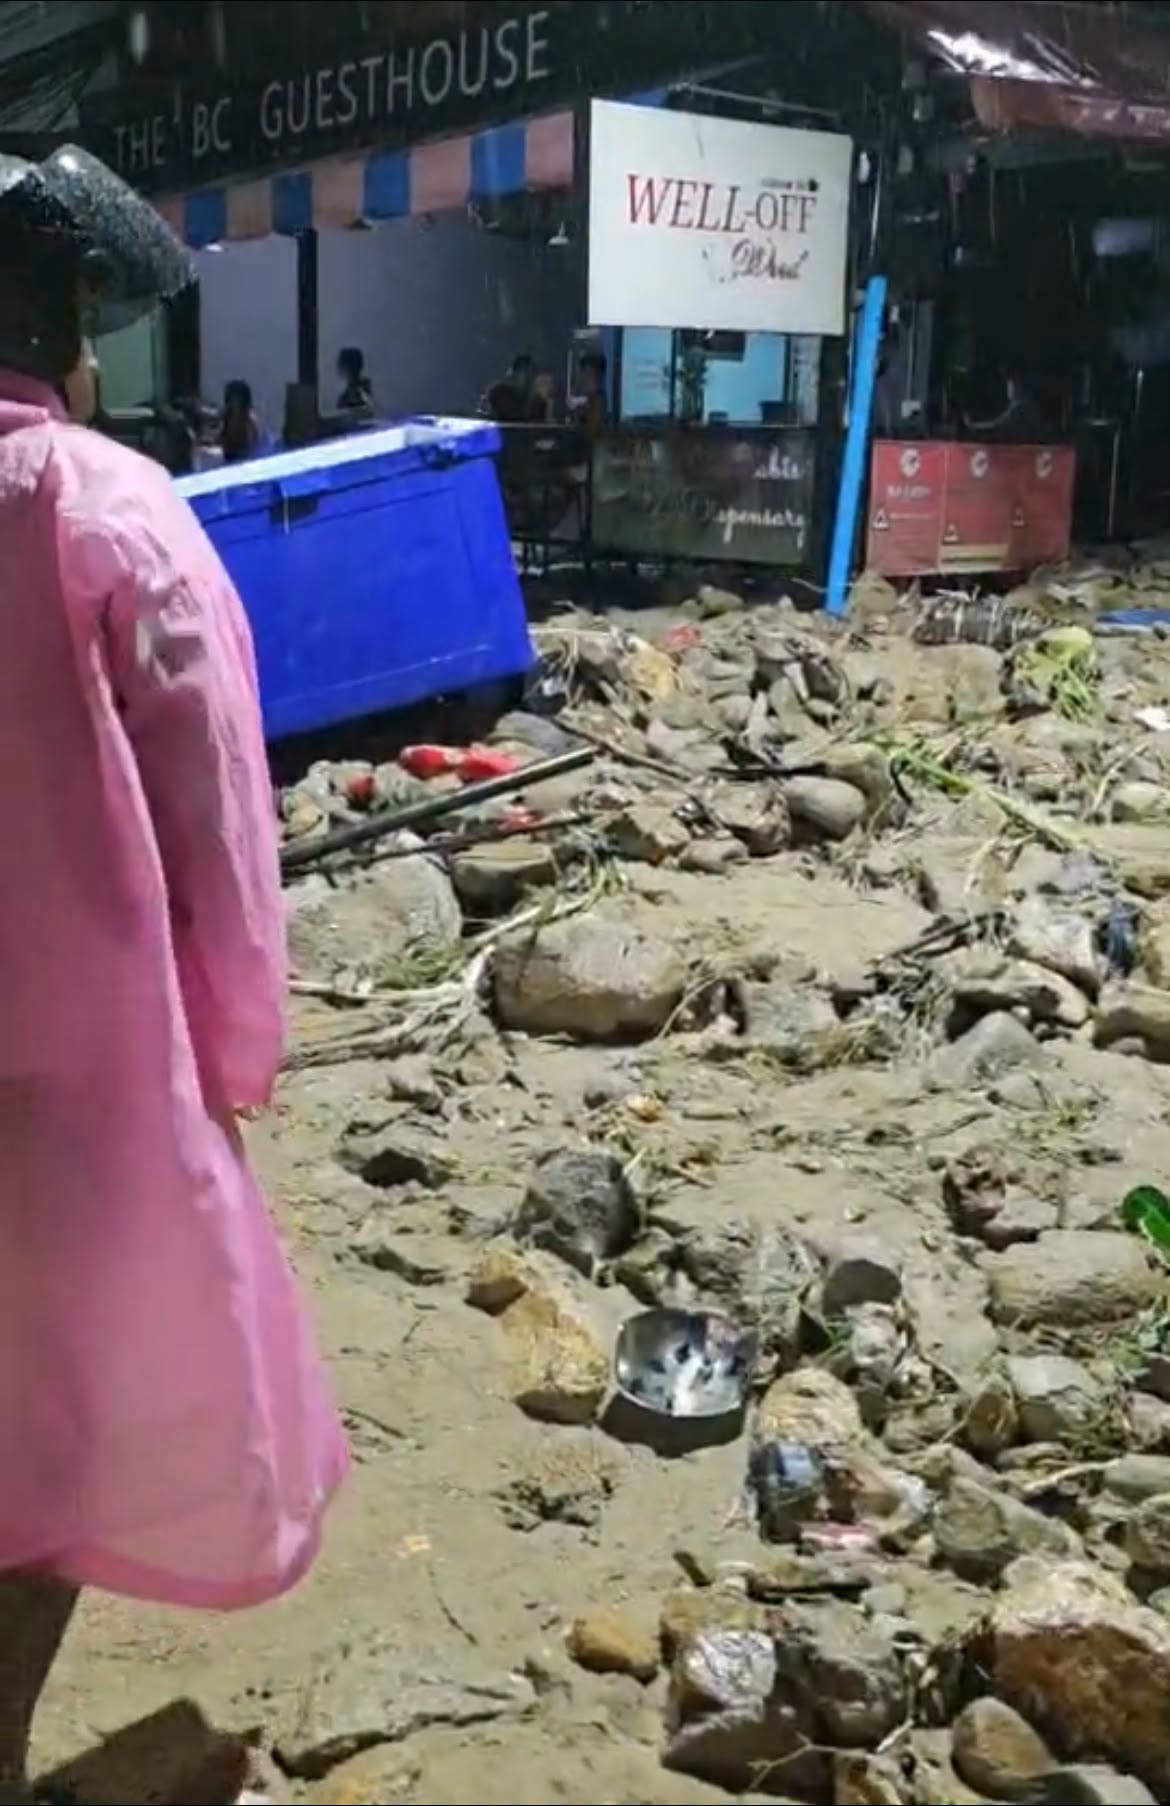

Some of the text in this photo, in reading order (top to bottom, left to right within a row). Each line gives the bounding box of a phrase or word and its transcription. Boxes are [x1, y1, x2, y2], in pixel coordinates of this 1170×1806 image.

[113, 114, 168, 170] THE
[260, 12, 550, 140] GUESTHOUSE
[627, 174, 818, 233] WELL-OFF
